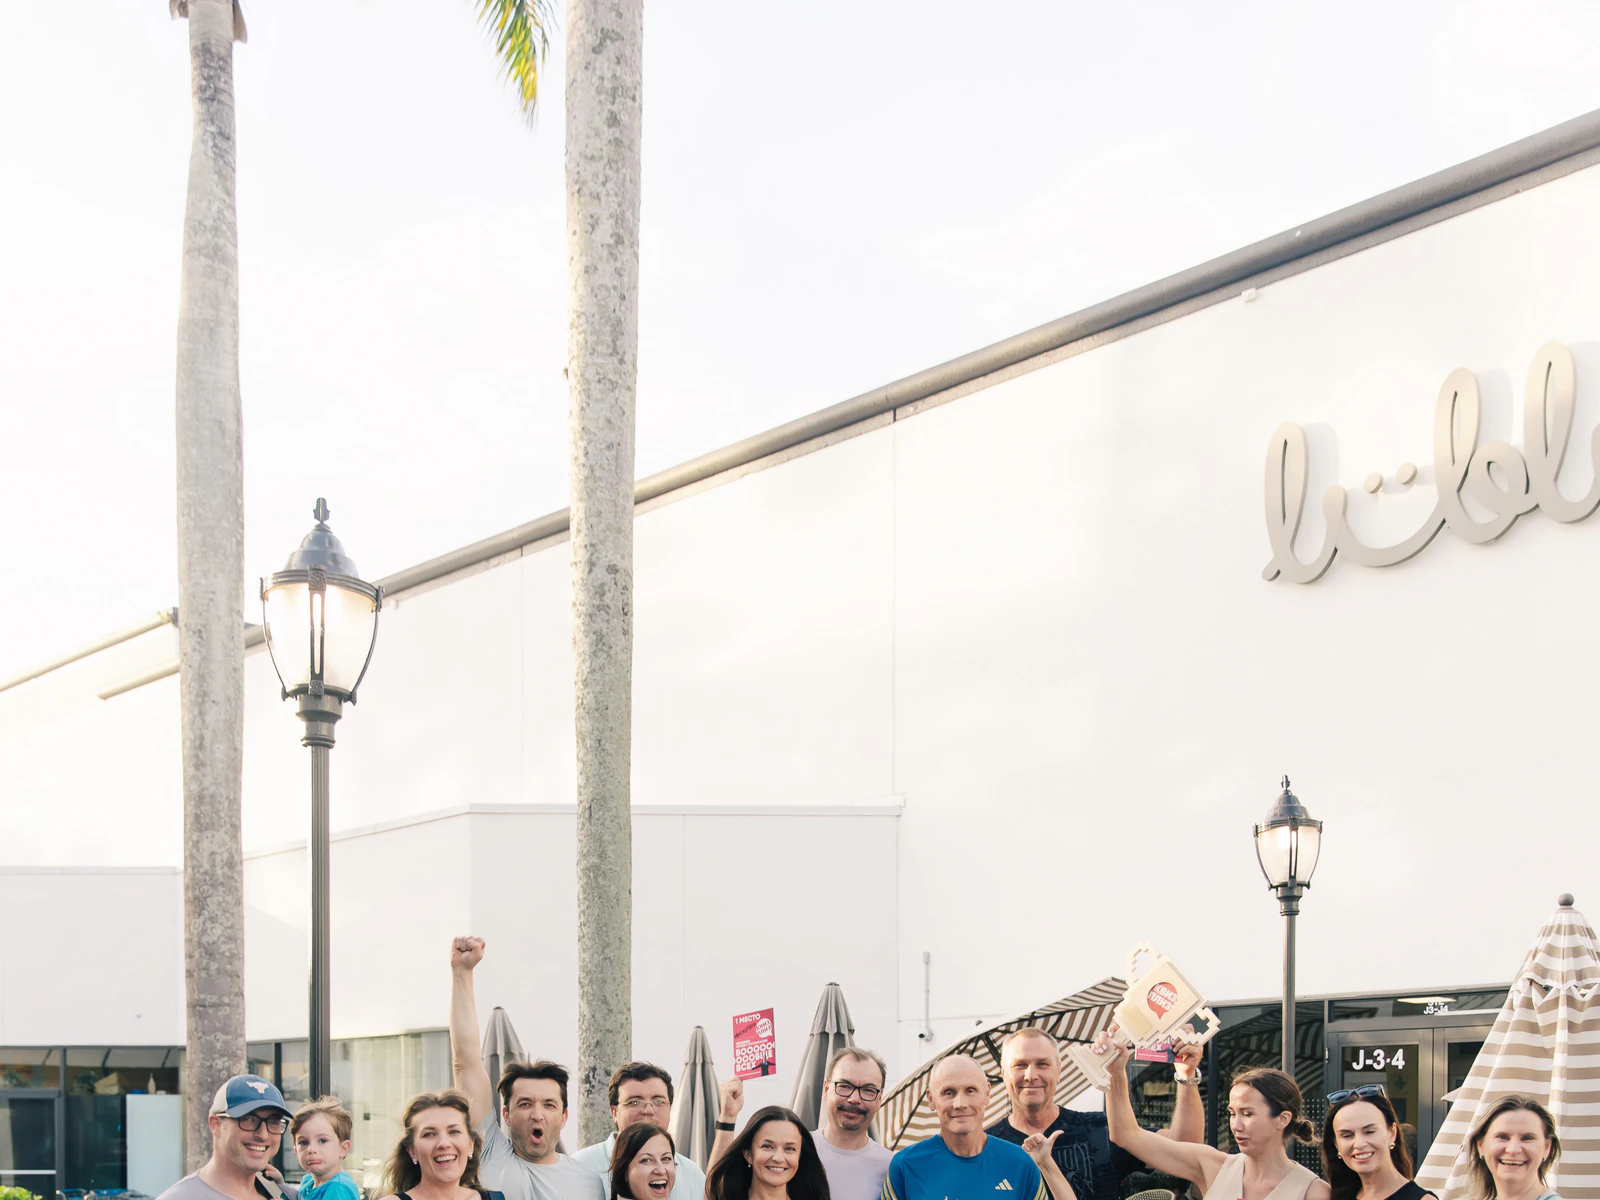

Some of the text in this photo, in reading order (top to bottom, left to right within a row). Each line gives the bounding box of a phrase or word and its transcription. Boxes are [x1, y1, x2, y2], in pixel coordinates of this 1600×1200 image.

[1262, 340, 1600, 584] lübl
[1423, 1004, 1449, 1015] J3-J4
[739, 1013, 761, 1024] МЕСТО
[733, 1049, 773, 1065] ОООБЩЕ
[736, 1060, 757, 1072] ВСЕХ
